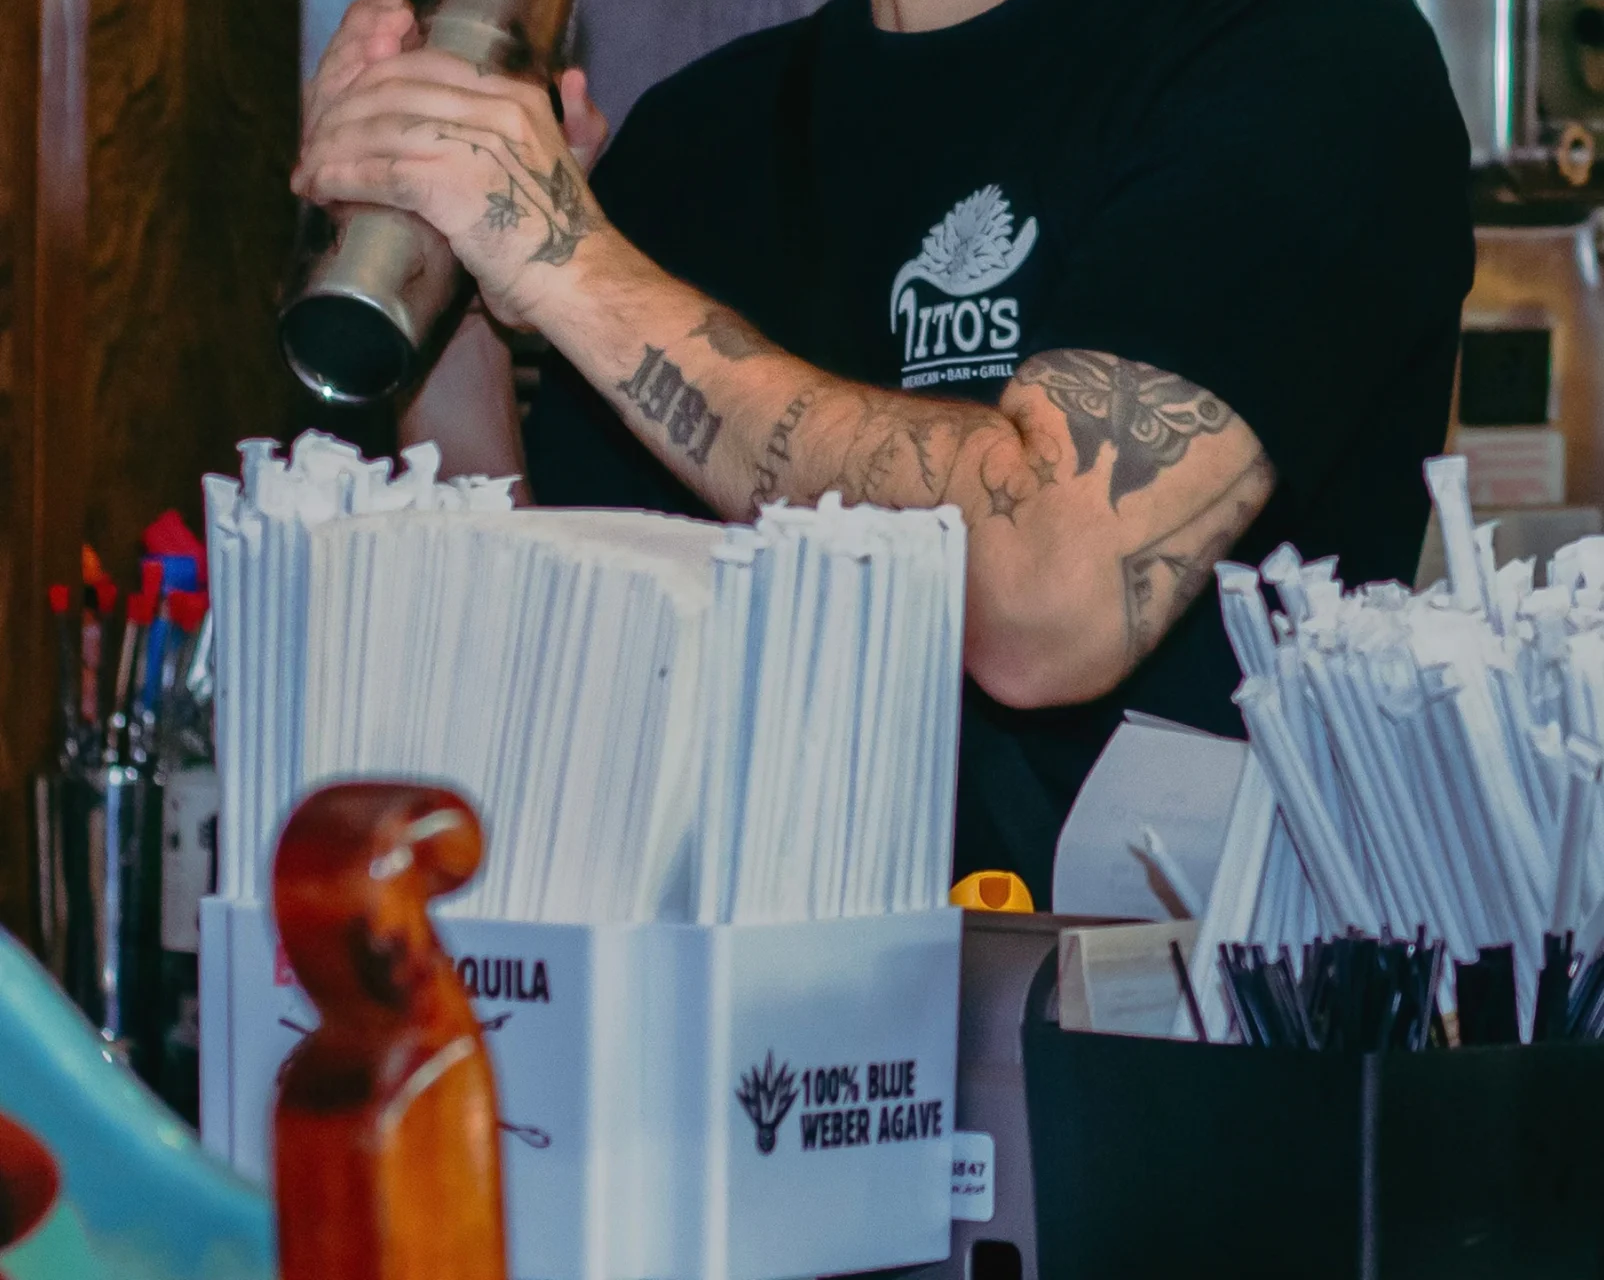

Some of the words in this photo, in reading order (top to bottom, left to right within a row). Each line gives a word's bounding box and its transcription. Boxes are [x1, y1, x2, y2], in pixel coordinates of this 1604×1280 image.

[903, 372, 939, 388] MEXICAN
[946, 368, 971, 381] BAR
[980, 364, 1013, 378] GRILL
[457, 956, 550, 1004] QUILA
[801, 1067, 859, 1105] 100%
[868, 1061, 915, 1100] BLUE
[802, 1109, 869, 1150] WEBER
[878, 1102, 942, 1143] AGAVE
